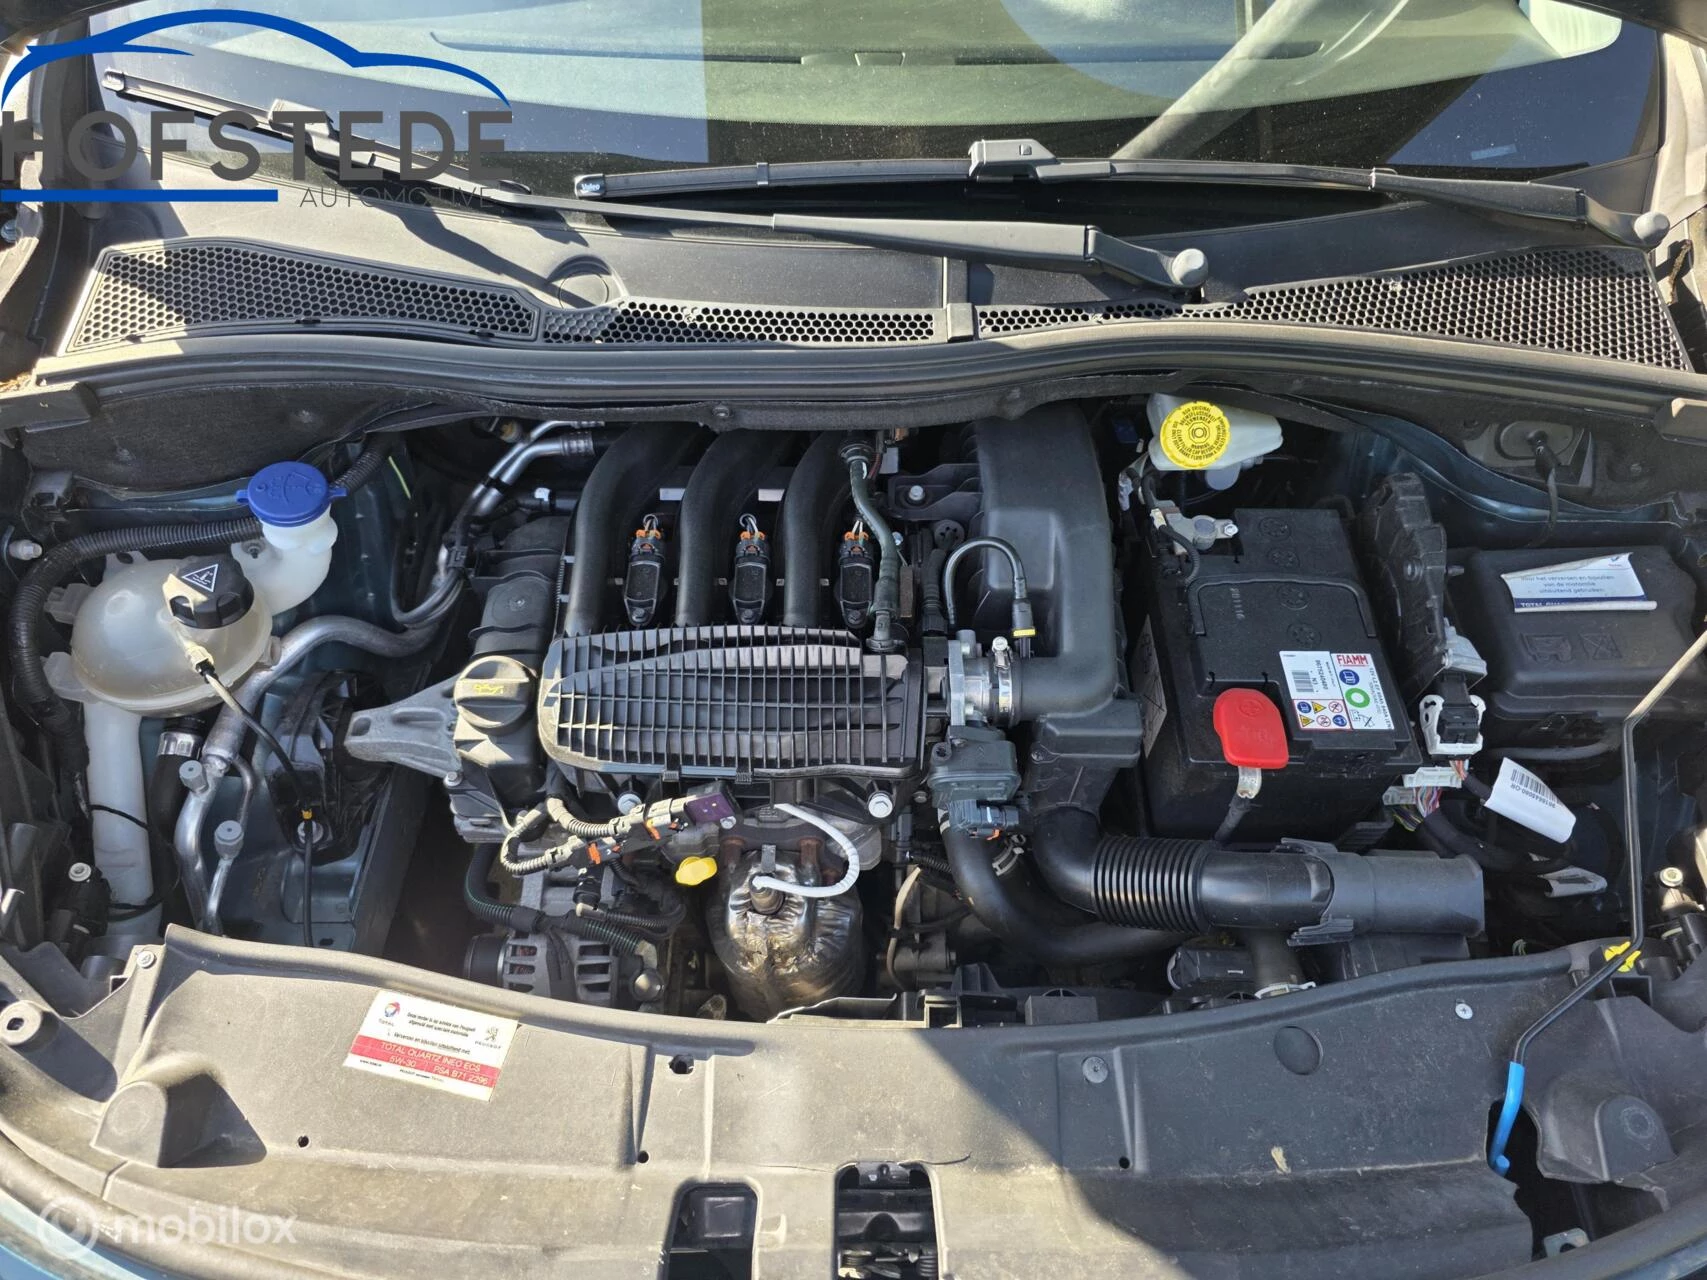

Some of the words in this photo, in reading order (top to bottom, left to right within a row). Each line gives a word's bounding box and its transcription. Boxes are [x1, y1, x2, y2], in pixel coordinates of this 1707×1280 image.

[581, 183, 600, 191] Valeo
[1336, 655, 1368, 665] FIAMM
[381, 1042, 406, 1055] TOTAL
[407, 1048, 441, 1063] QUARTZ
[442, 1056, 463, 1068] INEO
[464, 1061, 481, 1073] ECS
[389, 1055, 417, 1068] 5W-30
[433, 1065, 450, 1076] PSA
[452, 1069, 467, 1081] B71
